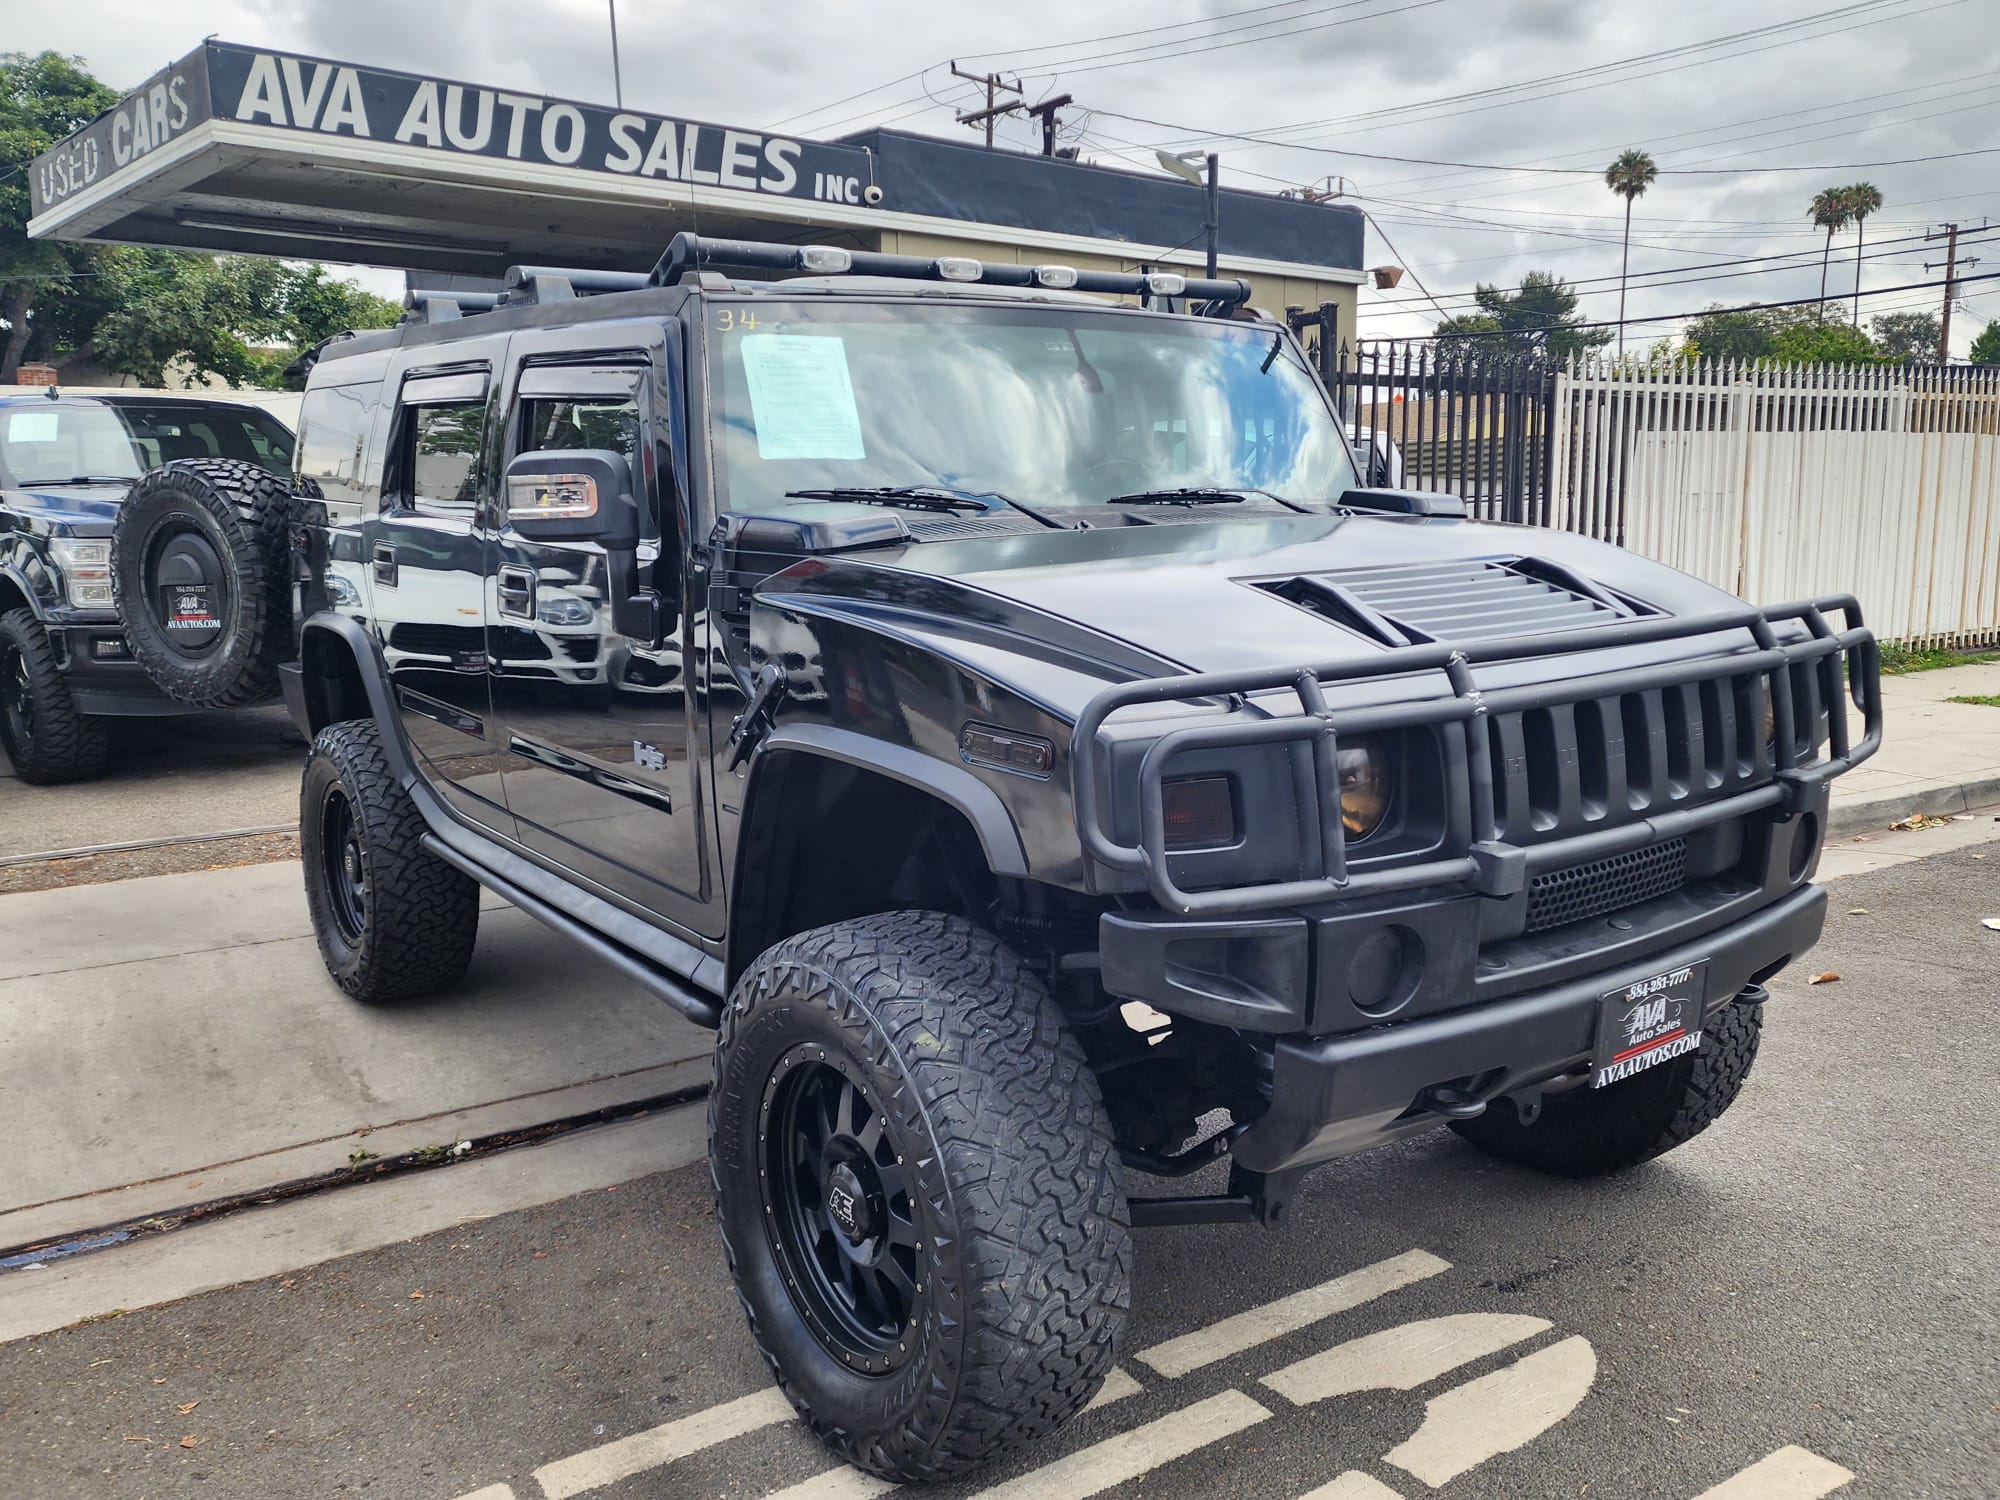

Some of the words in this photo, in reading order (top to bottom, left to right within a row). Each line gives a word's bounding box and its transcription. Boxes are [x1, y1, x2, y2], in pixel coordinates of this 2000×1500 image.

[40, 137, 98, 205] USED
[112, 75, 188, 167] CARS
[235, 53, 371, 137] AVA
[394, 80, 586, 164] AUTO
[604, 113, 802, 193] SALES
[814, 172, 859, 204] INC
[716, 308, 763, 332] 34
[181, 597, 198, 609] AVA
[167, 619, 221, 629] AVAAUTOS.COM
[1629, 997, 1666, 1034] AVA
[1628, 1031, 1654, 1047] Auto
[1655, 1018, 1681, 1037] Sales
[1595, 1031, 1703, 1089] AVAAUTOS.COM
